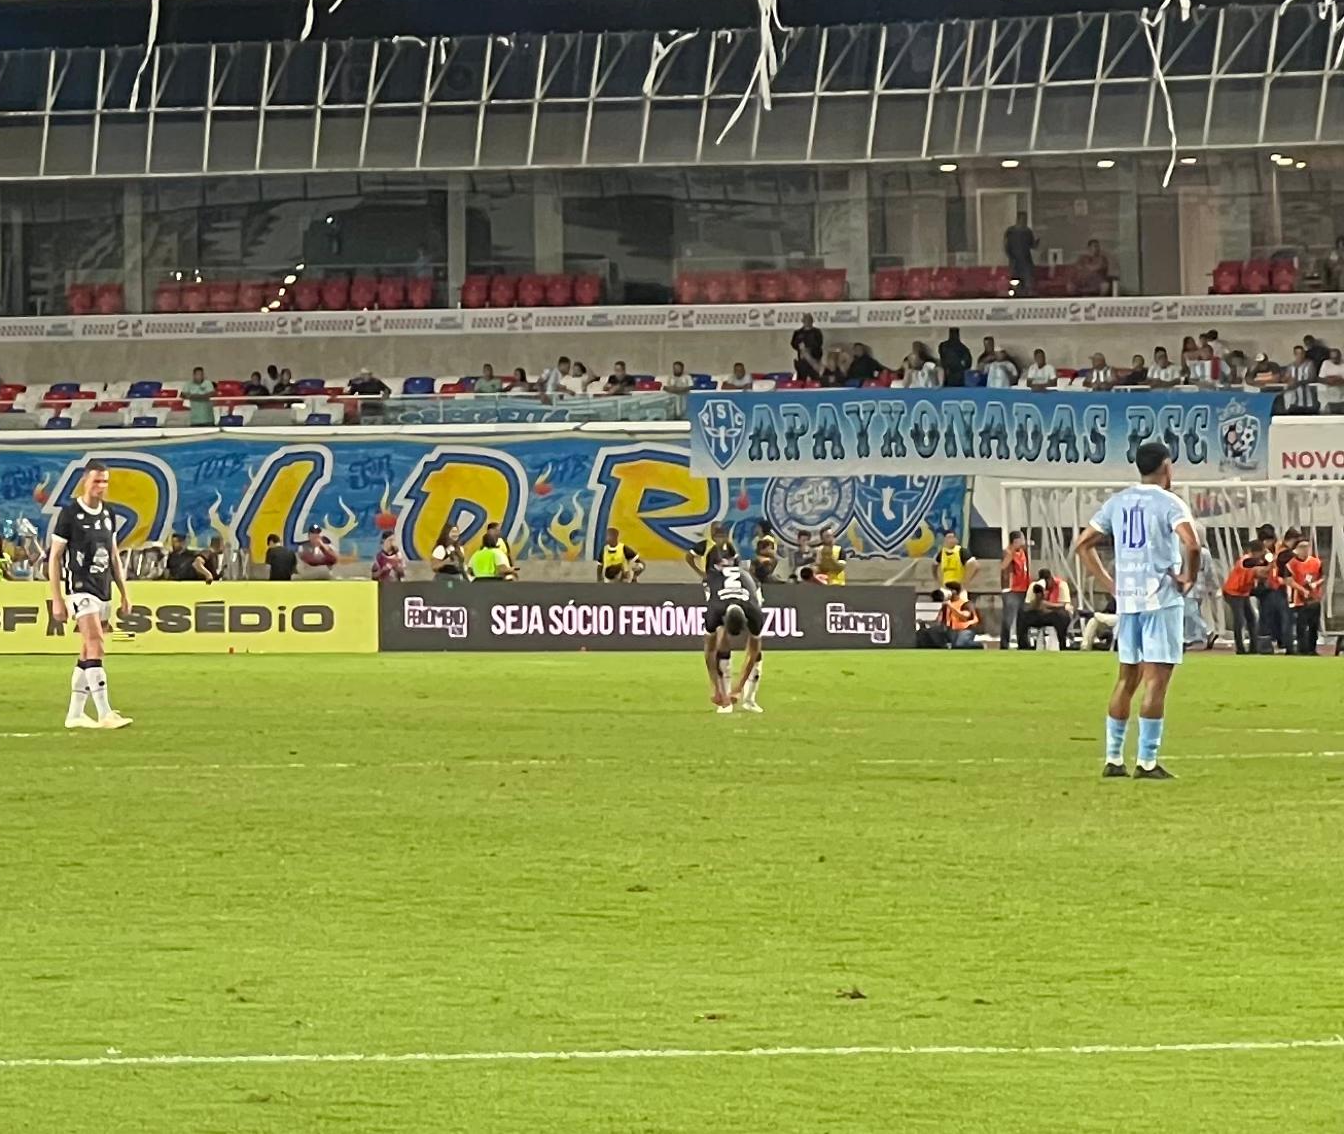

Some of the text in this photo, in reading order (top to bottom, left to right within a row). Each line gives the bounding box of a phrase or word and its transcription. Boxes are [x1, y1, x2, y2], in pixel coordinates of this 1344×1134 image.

[492, 600, 803, 637] SEJA SÓCIO FENÔME ZUL
